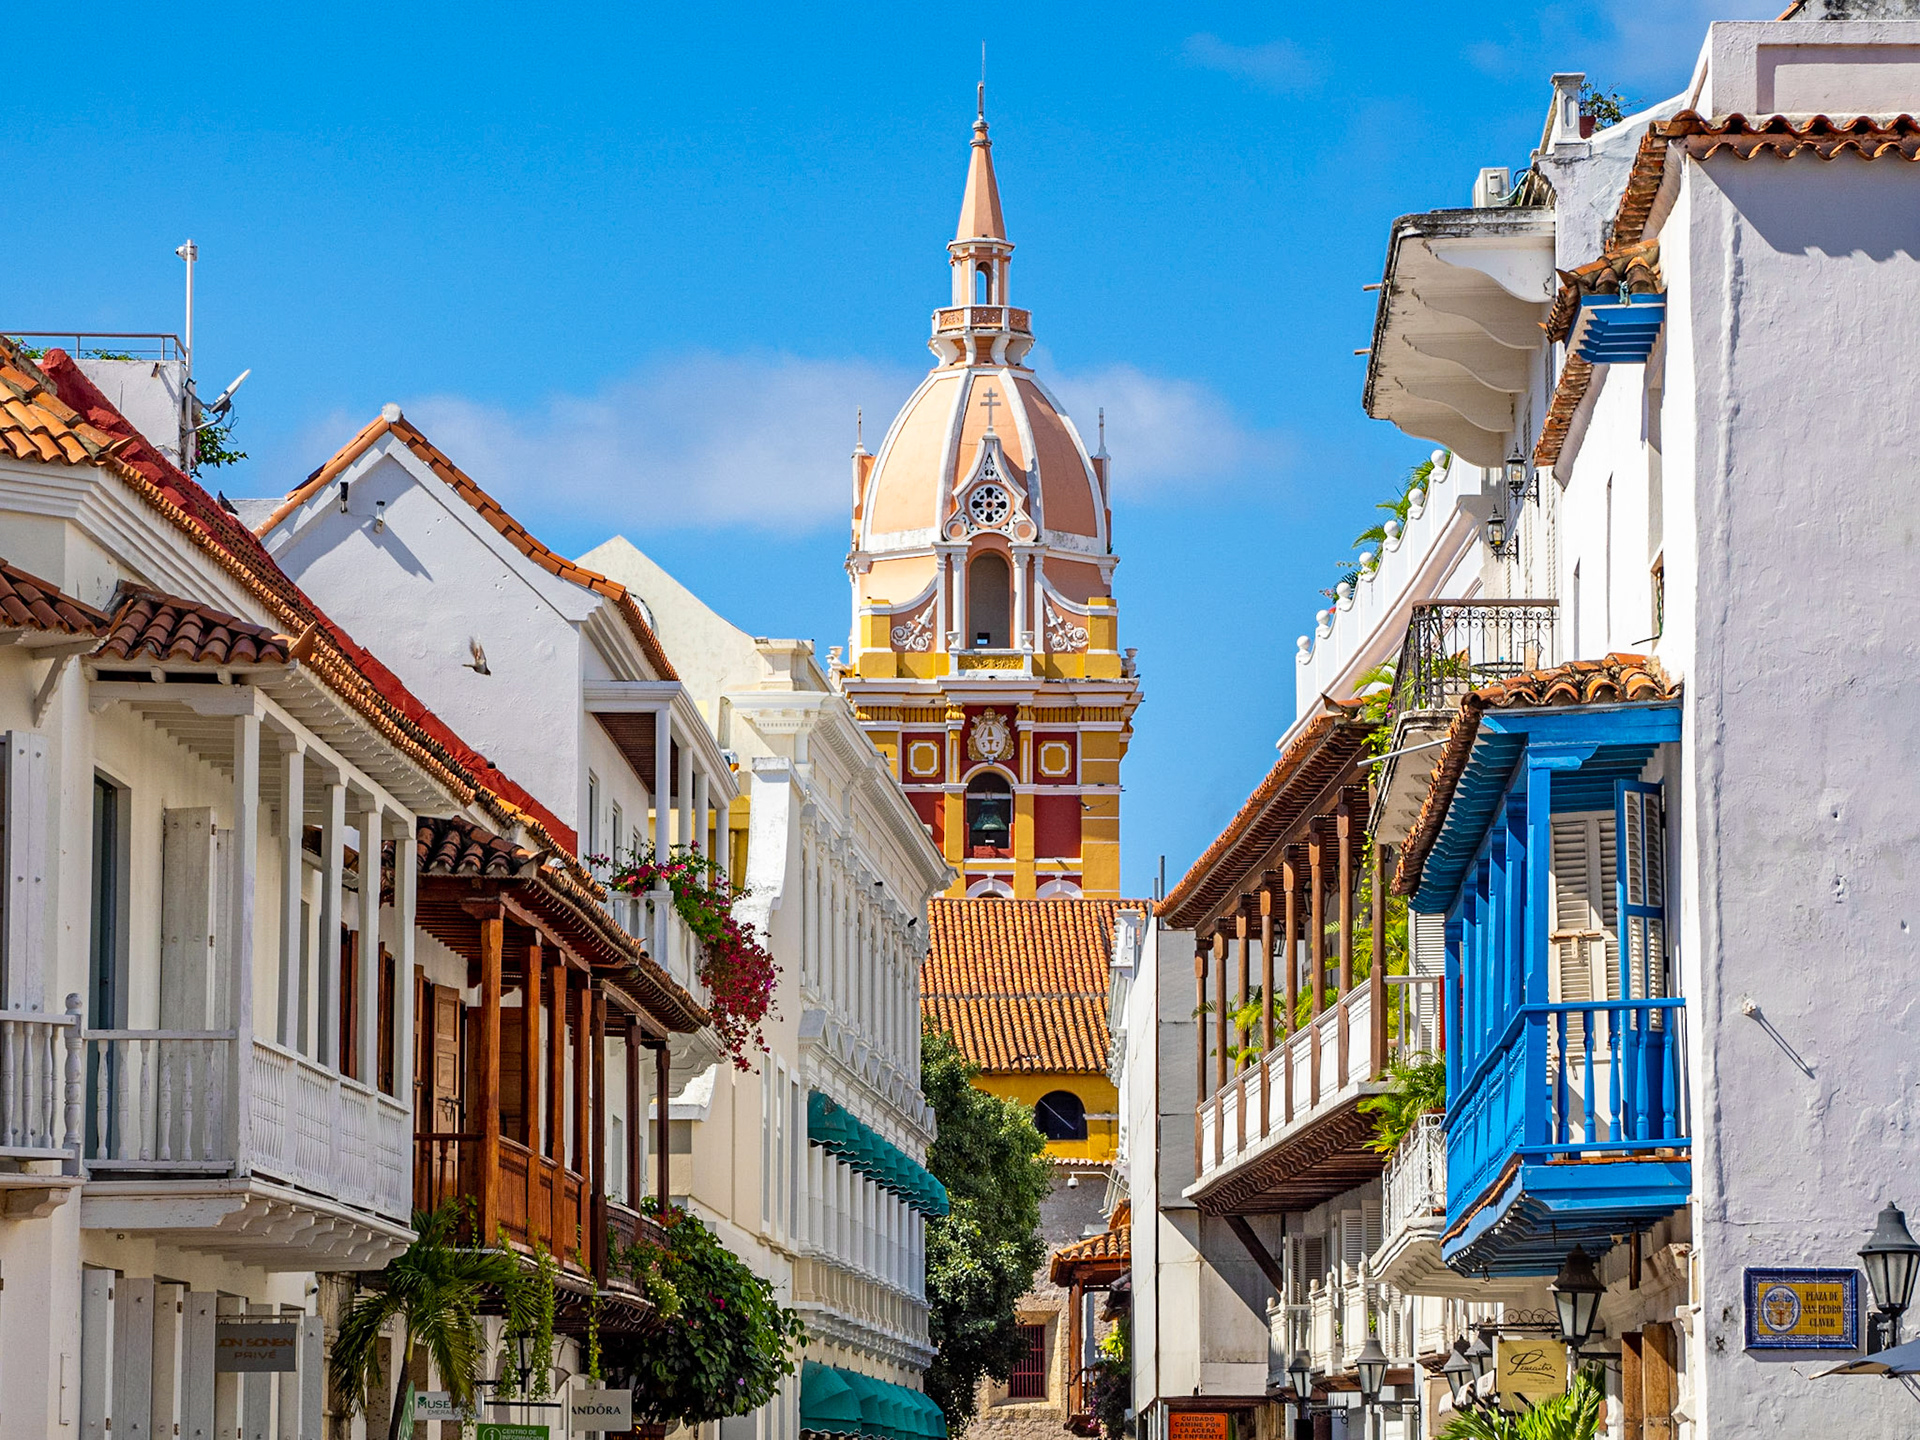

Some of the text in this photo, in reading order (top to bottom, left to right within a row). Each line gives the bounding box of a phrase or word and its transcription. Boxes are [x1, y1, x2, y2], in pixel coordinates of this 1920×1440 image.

[1805, 1291, 1839, 1301] PLAZA DE
[1803, 1304, 1842, 1314] SAN PEDRO
[1809, 1318, 1836, 1328] CLAVER
[246, 1337, 294, 1347] SONEN
[234, 1349, 277, 1359] PRIVÉ
[417, 1400, 451, 1409] MUSE
[571, 1403, 621, 1415] ANDORA
